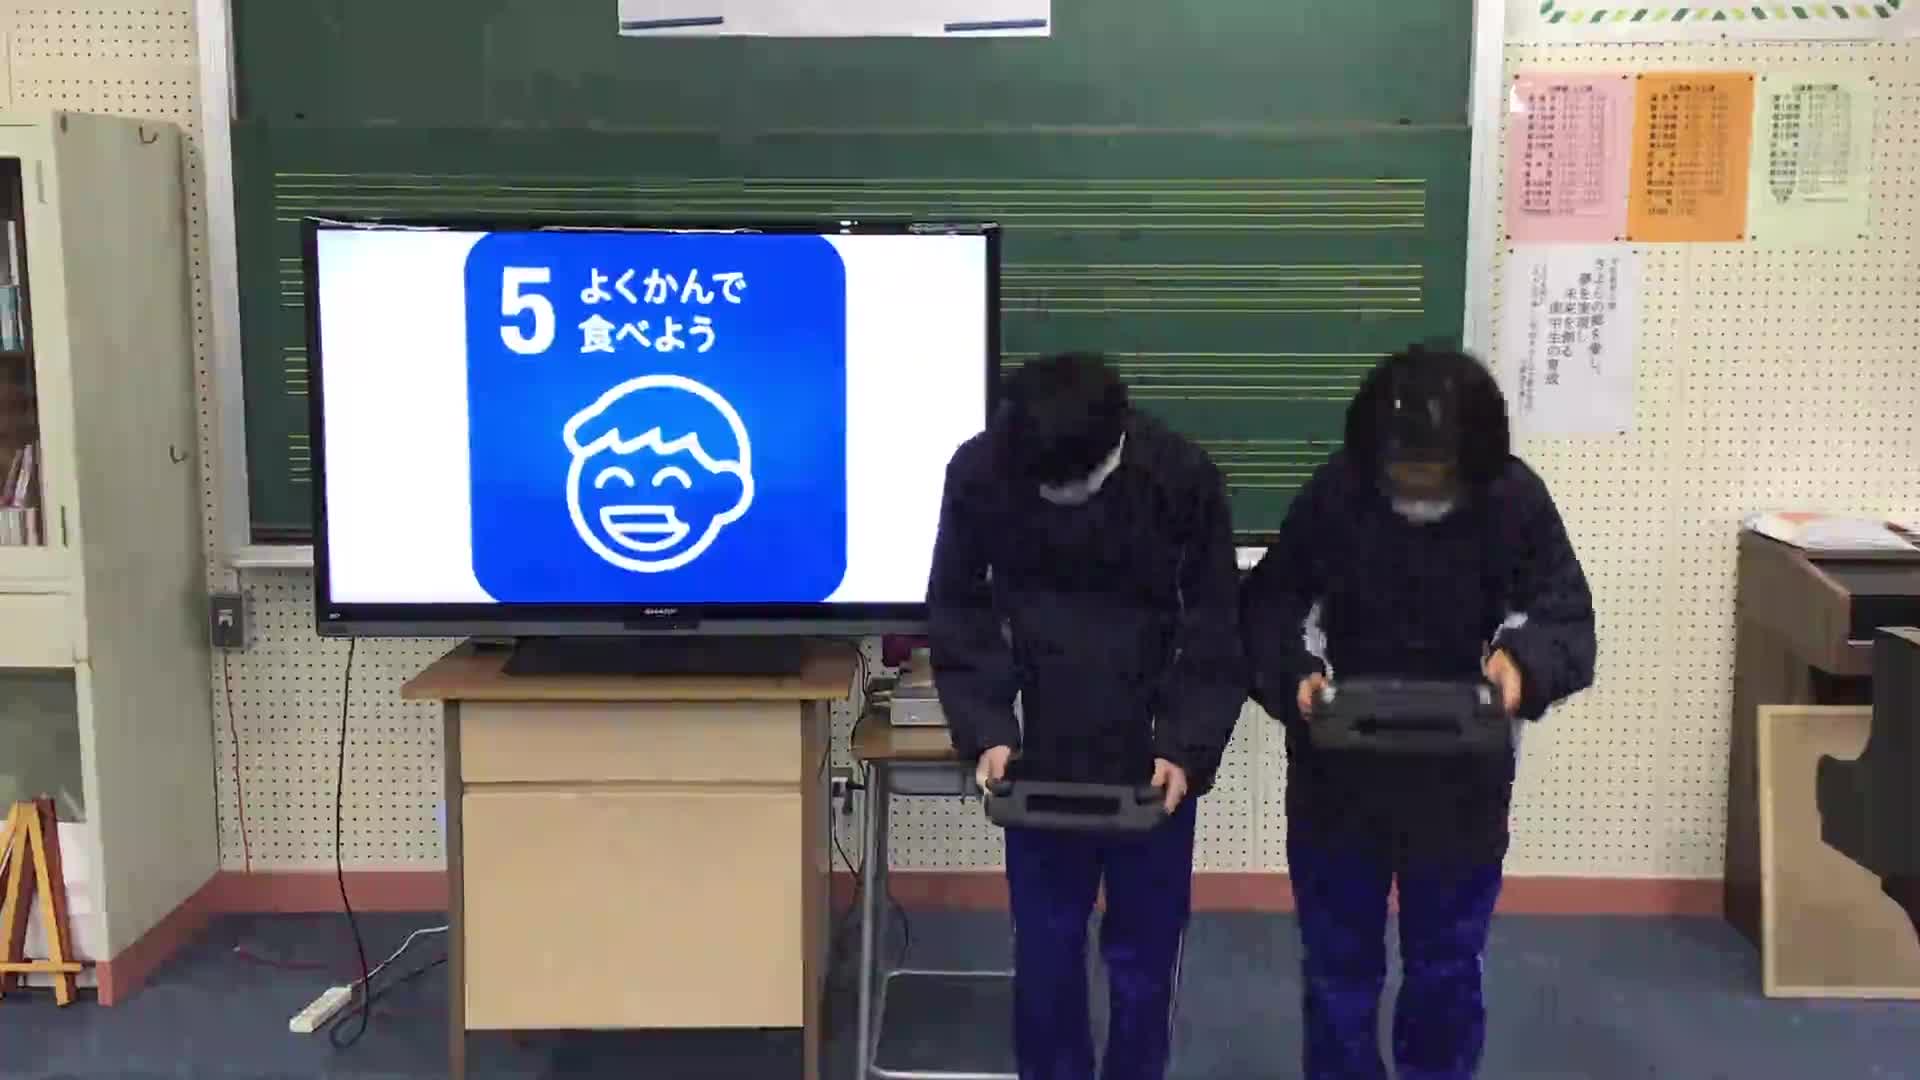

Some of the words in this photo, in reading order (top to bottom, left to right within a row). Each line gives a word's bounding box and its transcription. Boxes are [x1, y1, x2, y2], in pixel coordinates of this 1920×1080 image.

[580, 268, 747, 304] よくかんで
[500, 267, 556, 354] 5
[578, 314, 716, 353] 食べよう
